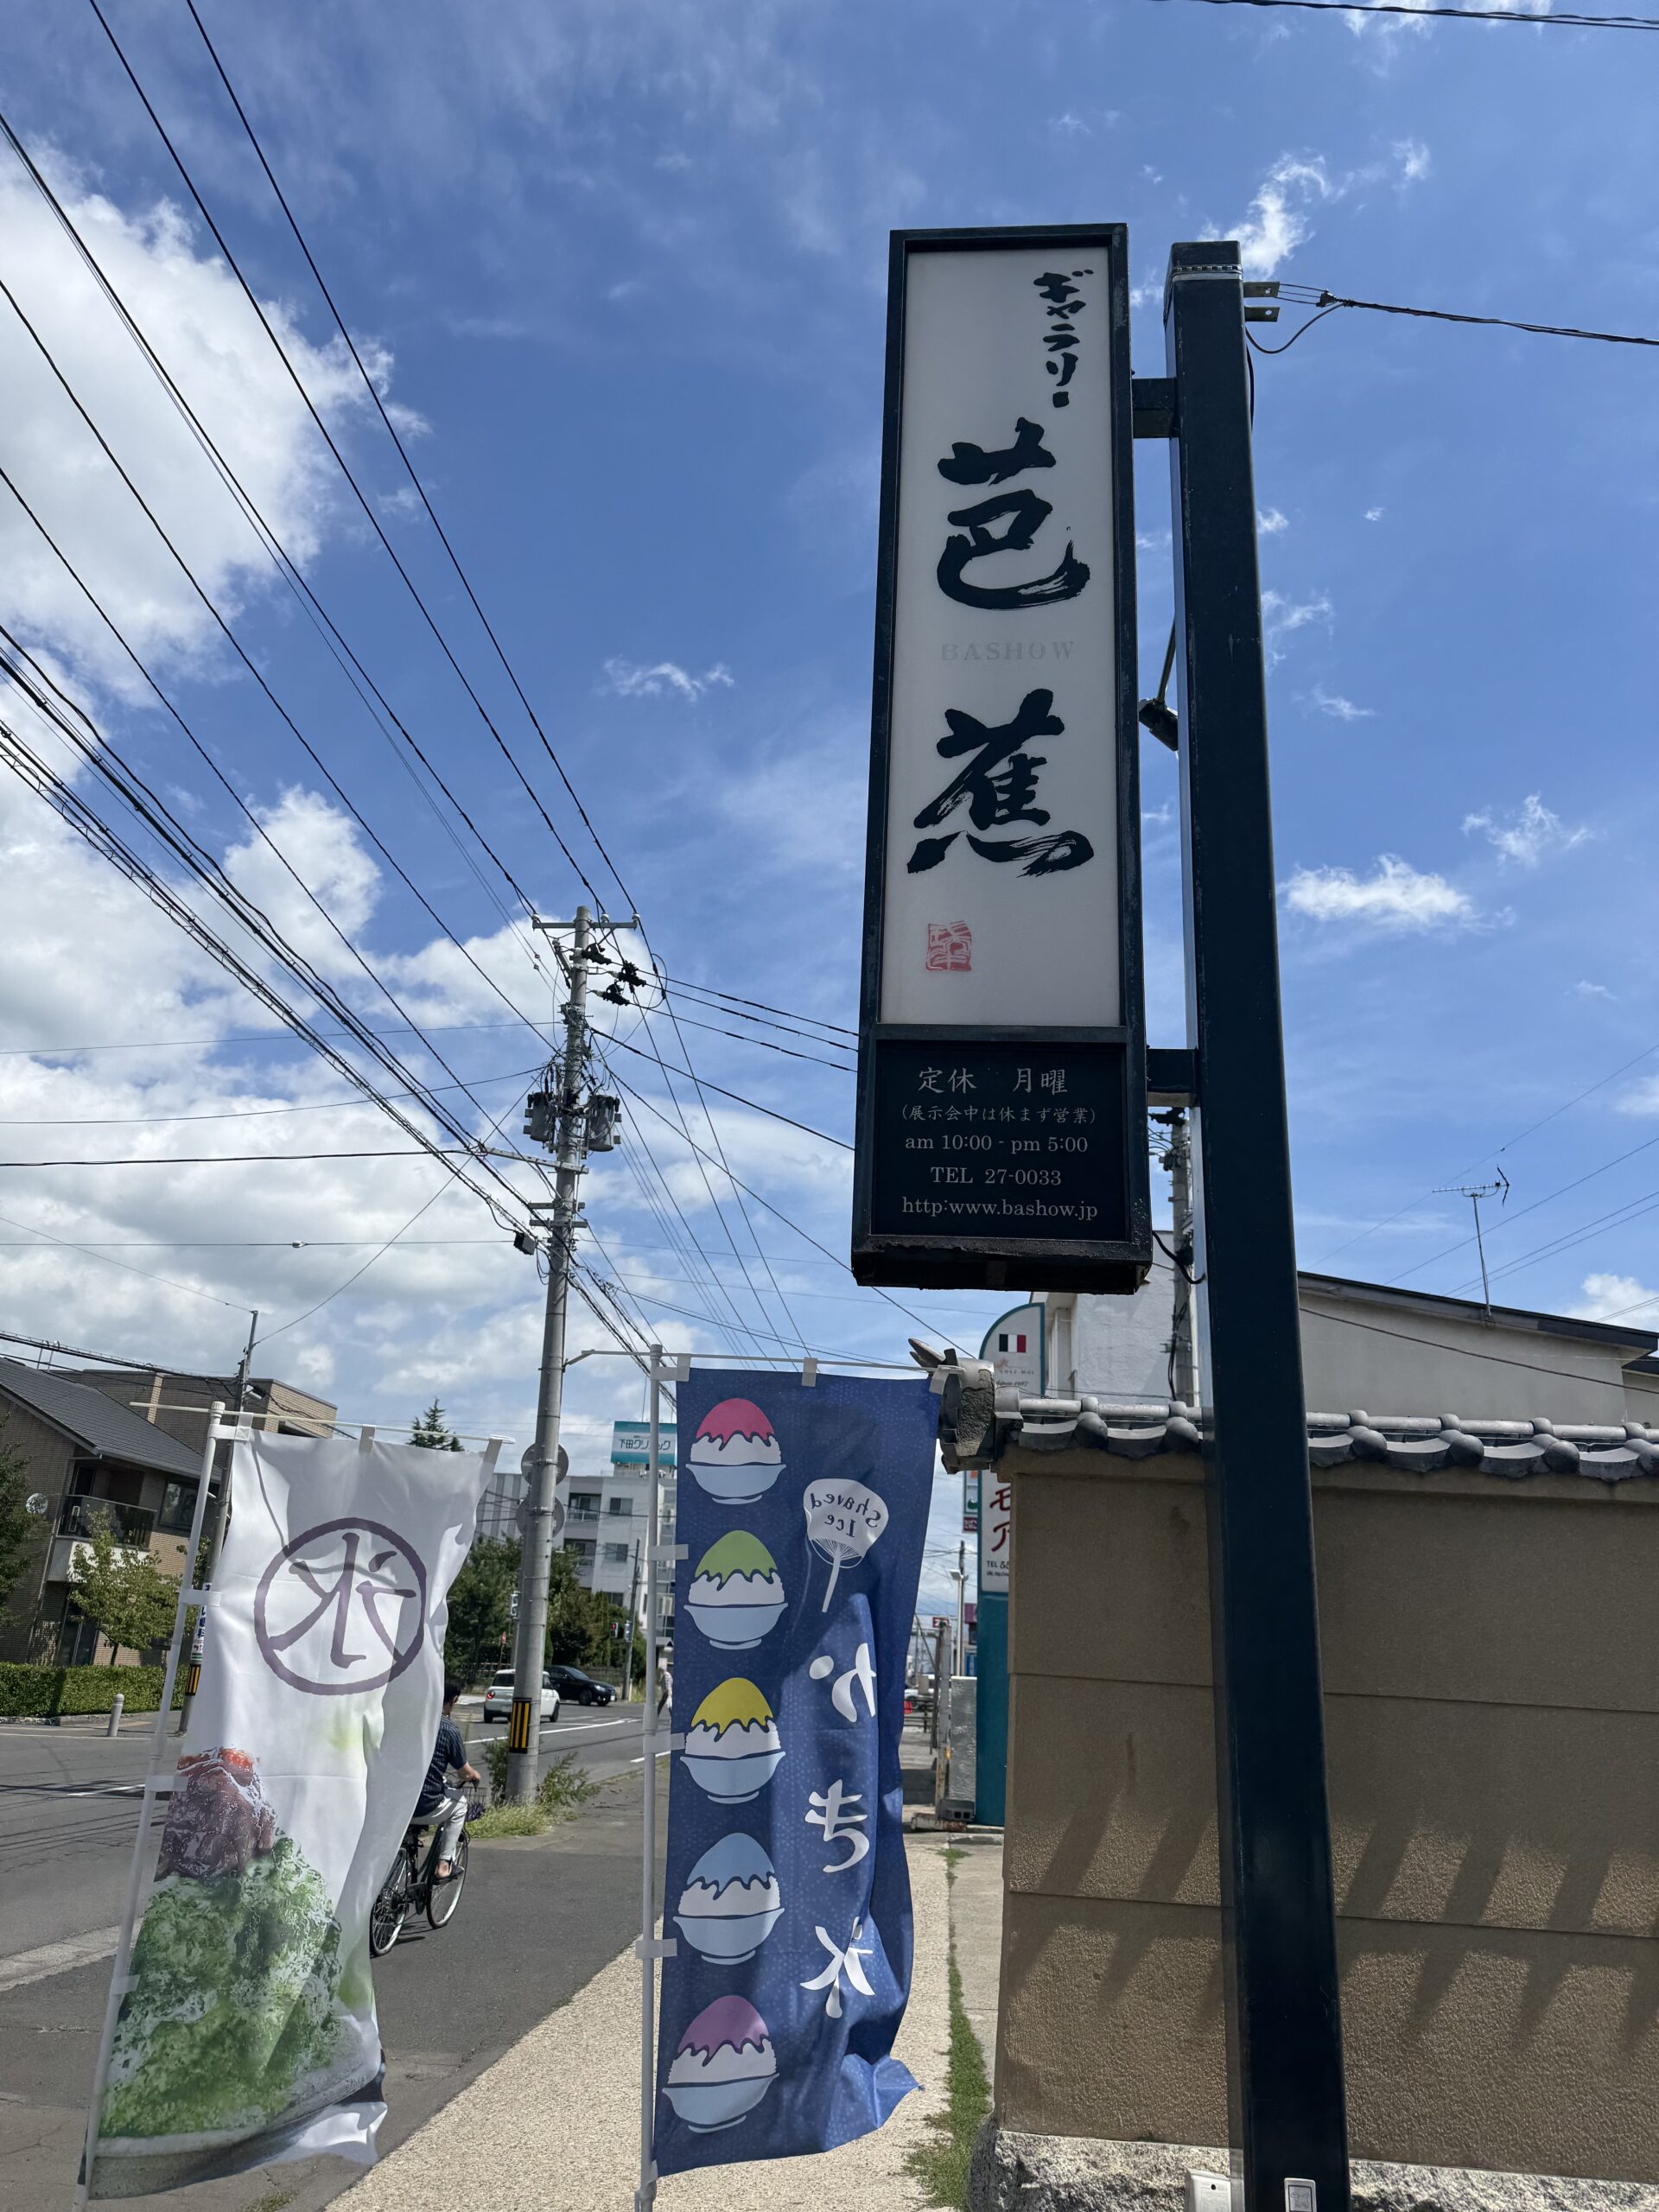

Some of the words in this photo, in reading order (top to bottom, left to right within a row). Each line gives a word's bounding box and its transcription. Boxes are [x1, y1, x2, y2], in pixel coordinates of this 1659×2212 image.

[941, 641, 1075, 660] BASHOW
[918, 1067, 977, 1094] 定休
[1012, 1067, 1068, 1096] 月曜
[902, 1105, 1096, 1124] (展示会中は休まず営業)
[906, 1138, 934, 1149] am
[942, 1135, 992, 1150] 10:00
[1011, 1139, 1040, 1154] pm
[1048, 1136, 1088, 1153] 5:00
[931, 1166, 974, 1184] TEL
[985, 1168, 1062, 1186] 27-0033
[619, 1439, 671, 1451] 下田クリック
